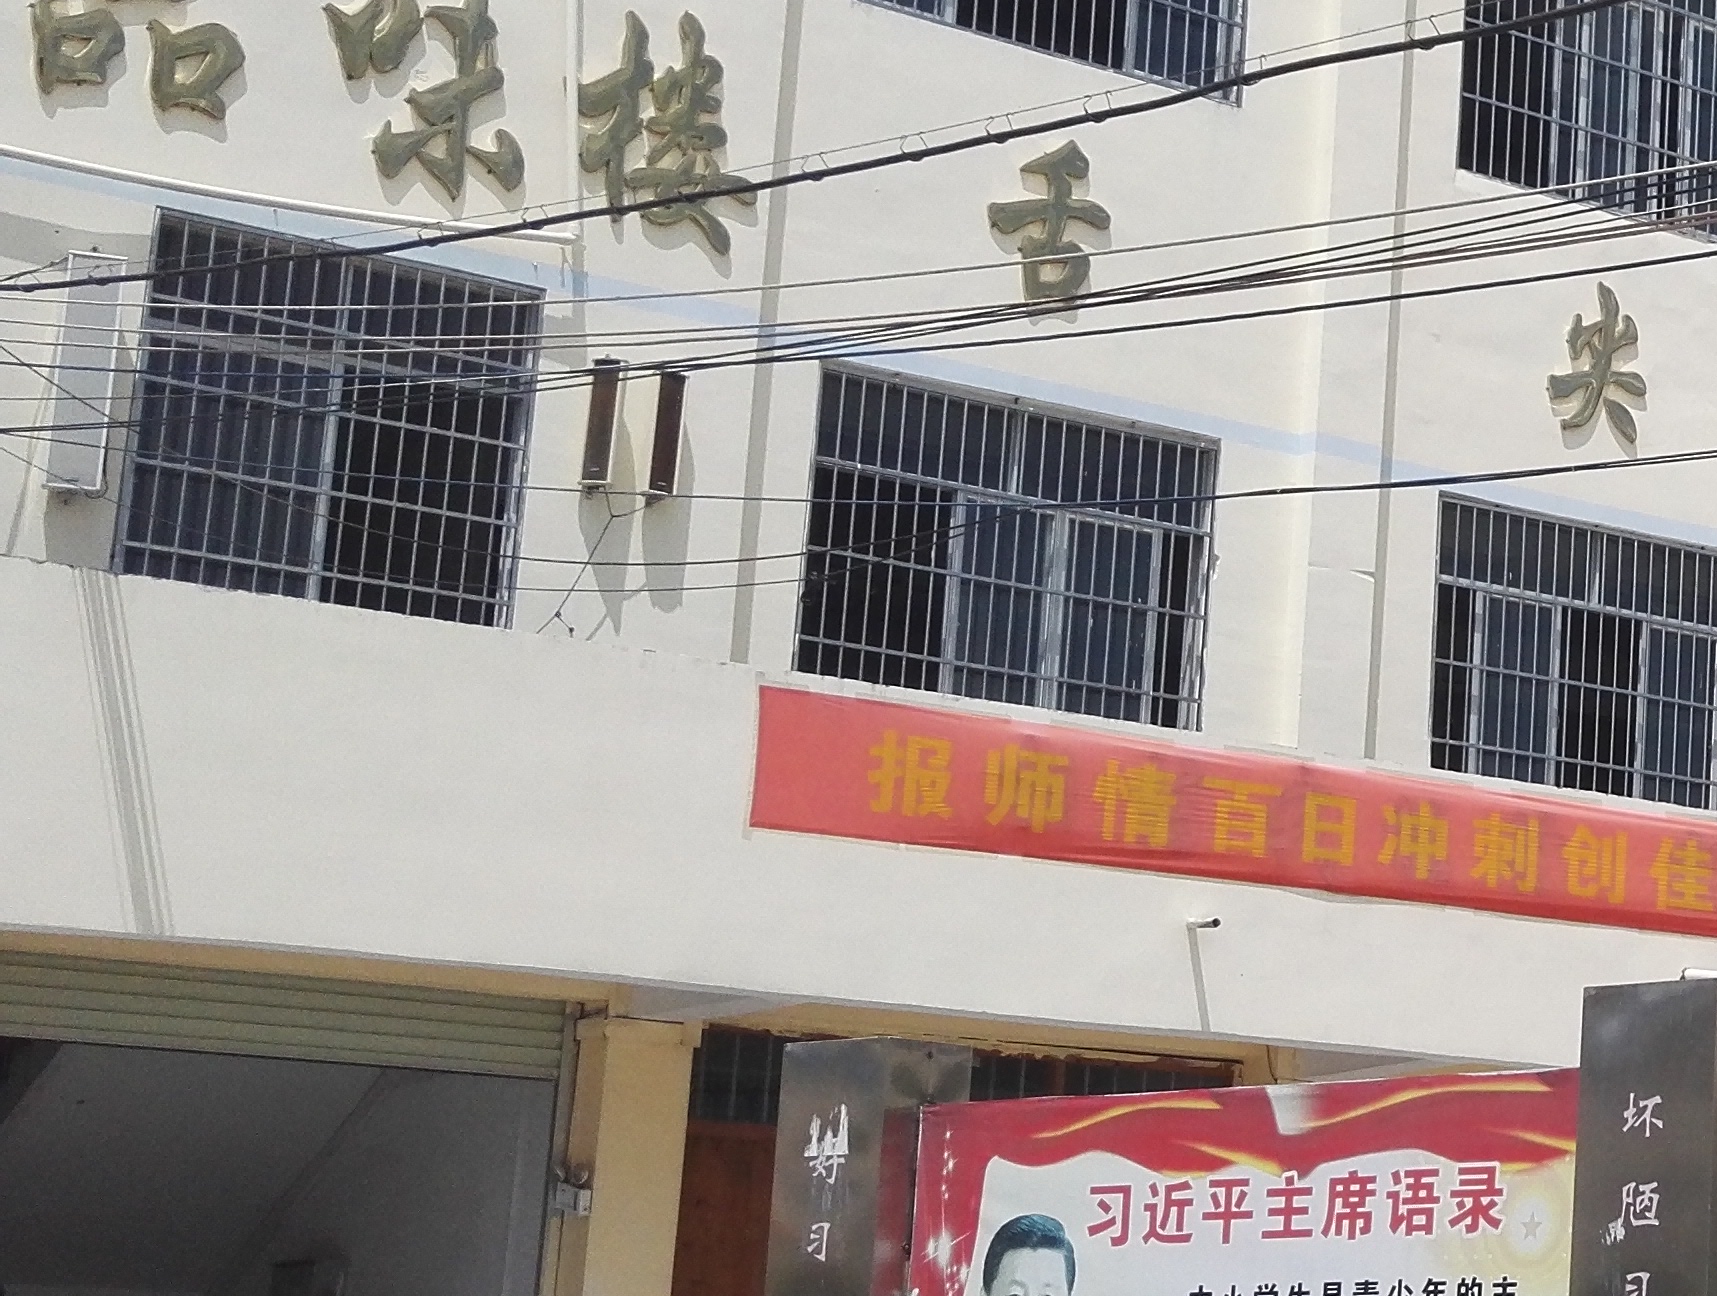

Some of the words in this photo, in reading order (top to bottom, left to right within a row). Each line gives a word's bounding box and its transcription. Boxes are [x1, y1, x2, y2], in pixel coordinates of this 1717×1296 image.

[1085, 1160, 1507, 1248] 习近平主席语录
